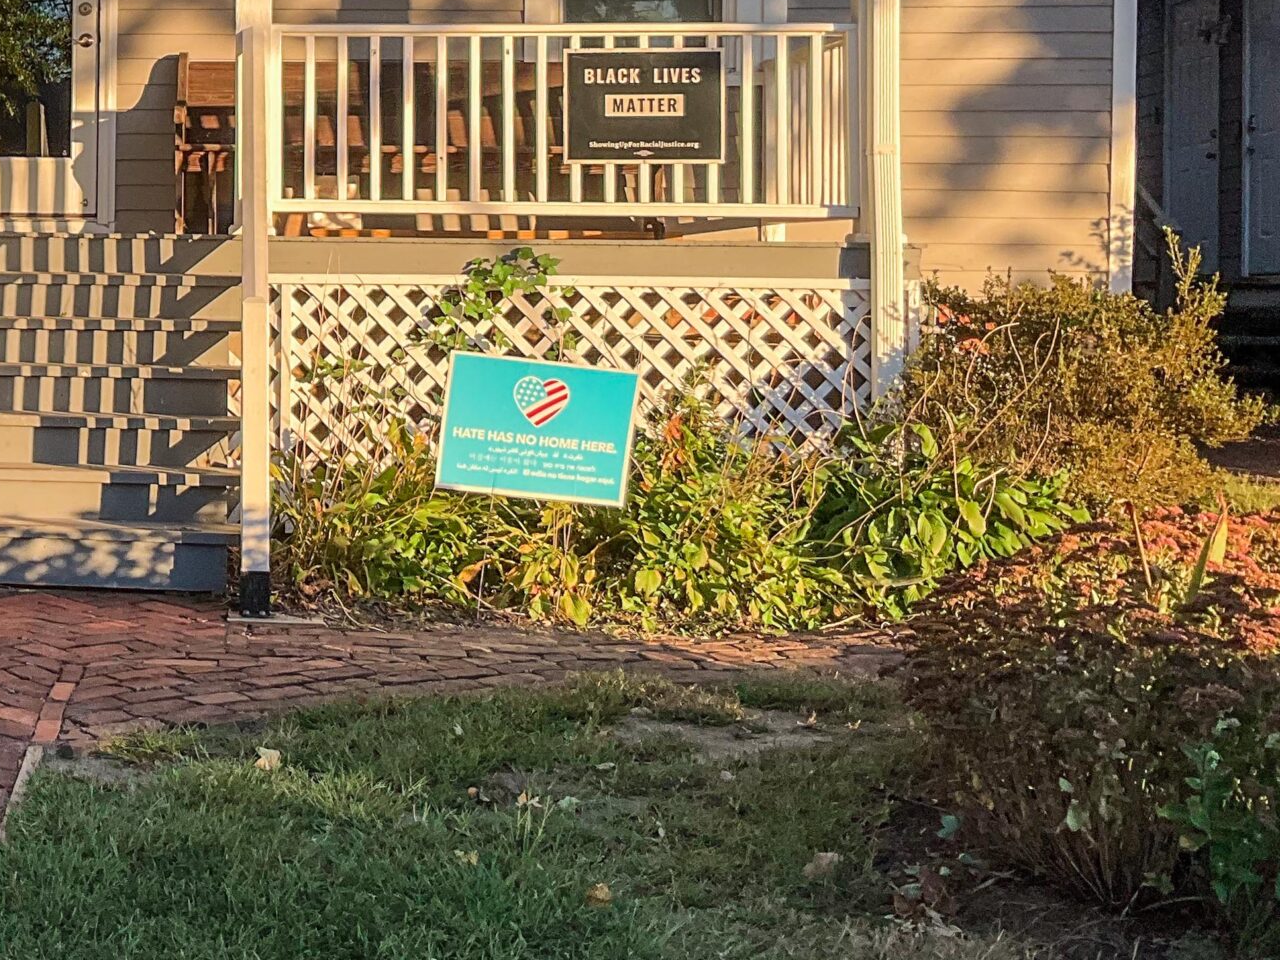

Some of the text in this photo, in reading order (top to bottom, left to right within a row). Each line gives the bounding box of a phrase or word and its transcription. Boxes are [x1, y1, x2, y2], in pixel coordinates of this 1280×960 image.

[584, 67, 701, 84] BLACK LIVES
[612, 98, 678, 113] MATTER
[452, 426, 486, 441] HATE
[487, 429, 514, 444] HAS
[515, 432, 538, 446] NO
[539, 435, 579, 451] HOME
[580, 439, 618, 454] HERE.
